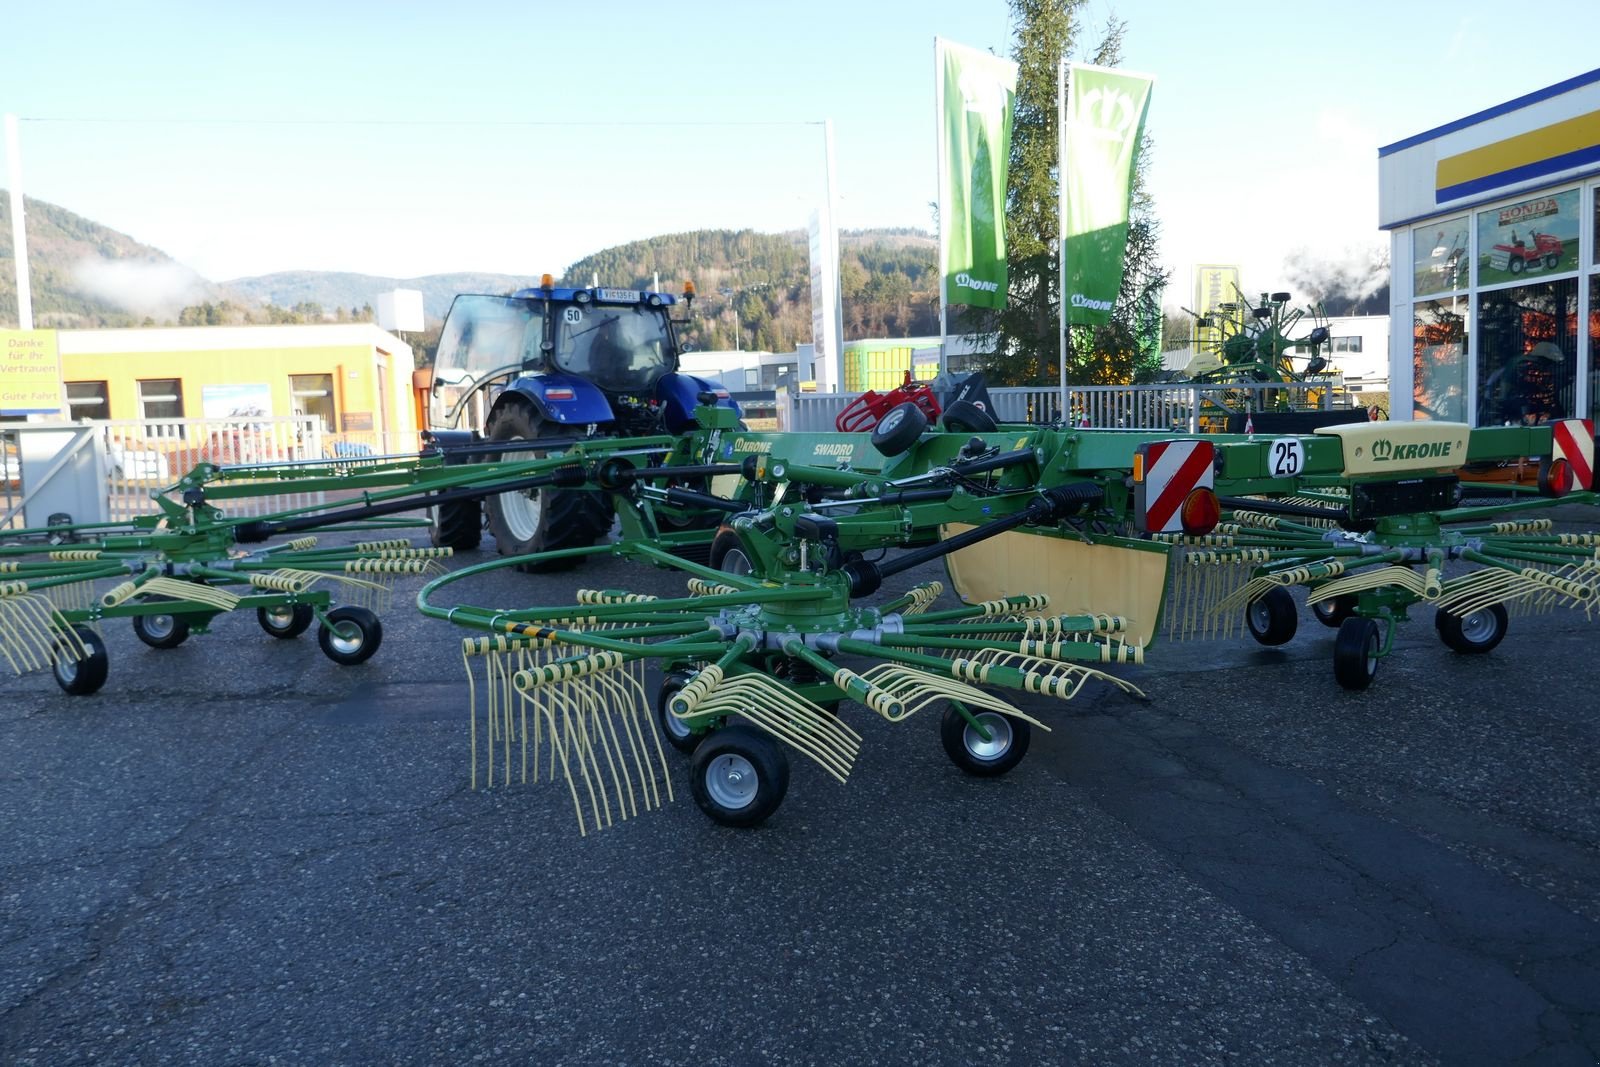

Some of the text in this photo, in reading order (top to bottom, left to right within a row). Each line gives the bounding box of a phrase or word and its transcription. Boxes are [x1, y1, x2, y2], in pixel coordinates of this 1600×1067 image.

[1499, 199, 1558, 220] HONDA
[567, 309, 580, 322] 50
[8, 339, 44, 348] Danke
[8, 351, 44, 360] für Ihr
[0, 364, 56, 373] Vertrauen
[2, 392, 57, 401] Gute Fahrt
[742, 441, 773, 453] KRONE
[813, 443, 854, 456] SWADRO
[1391, 441, 1452, 460] KRONE
[1275, 442, 1298, 475] 25
